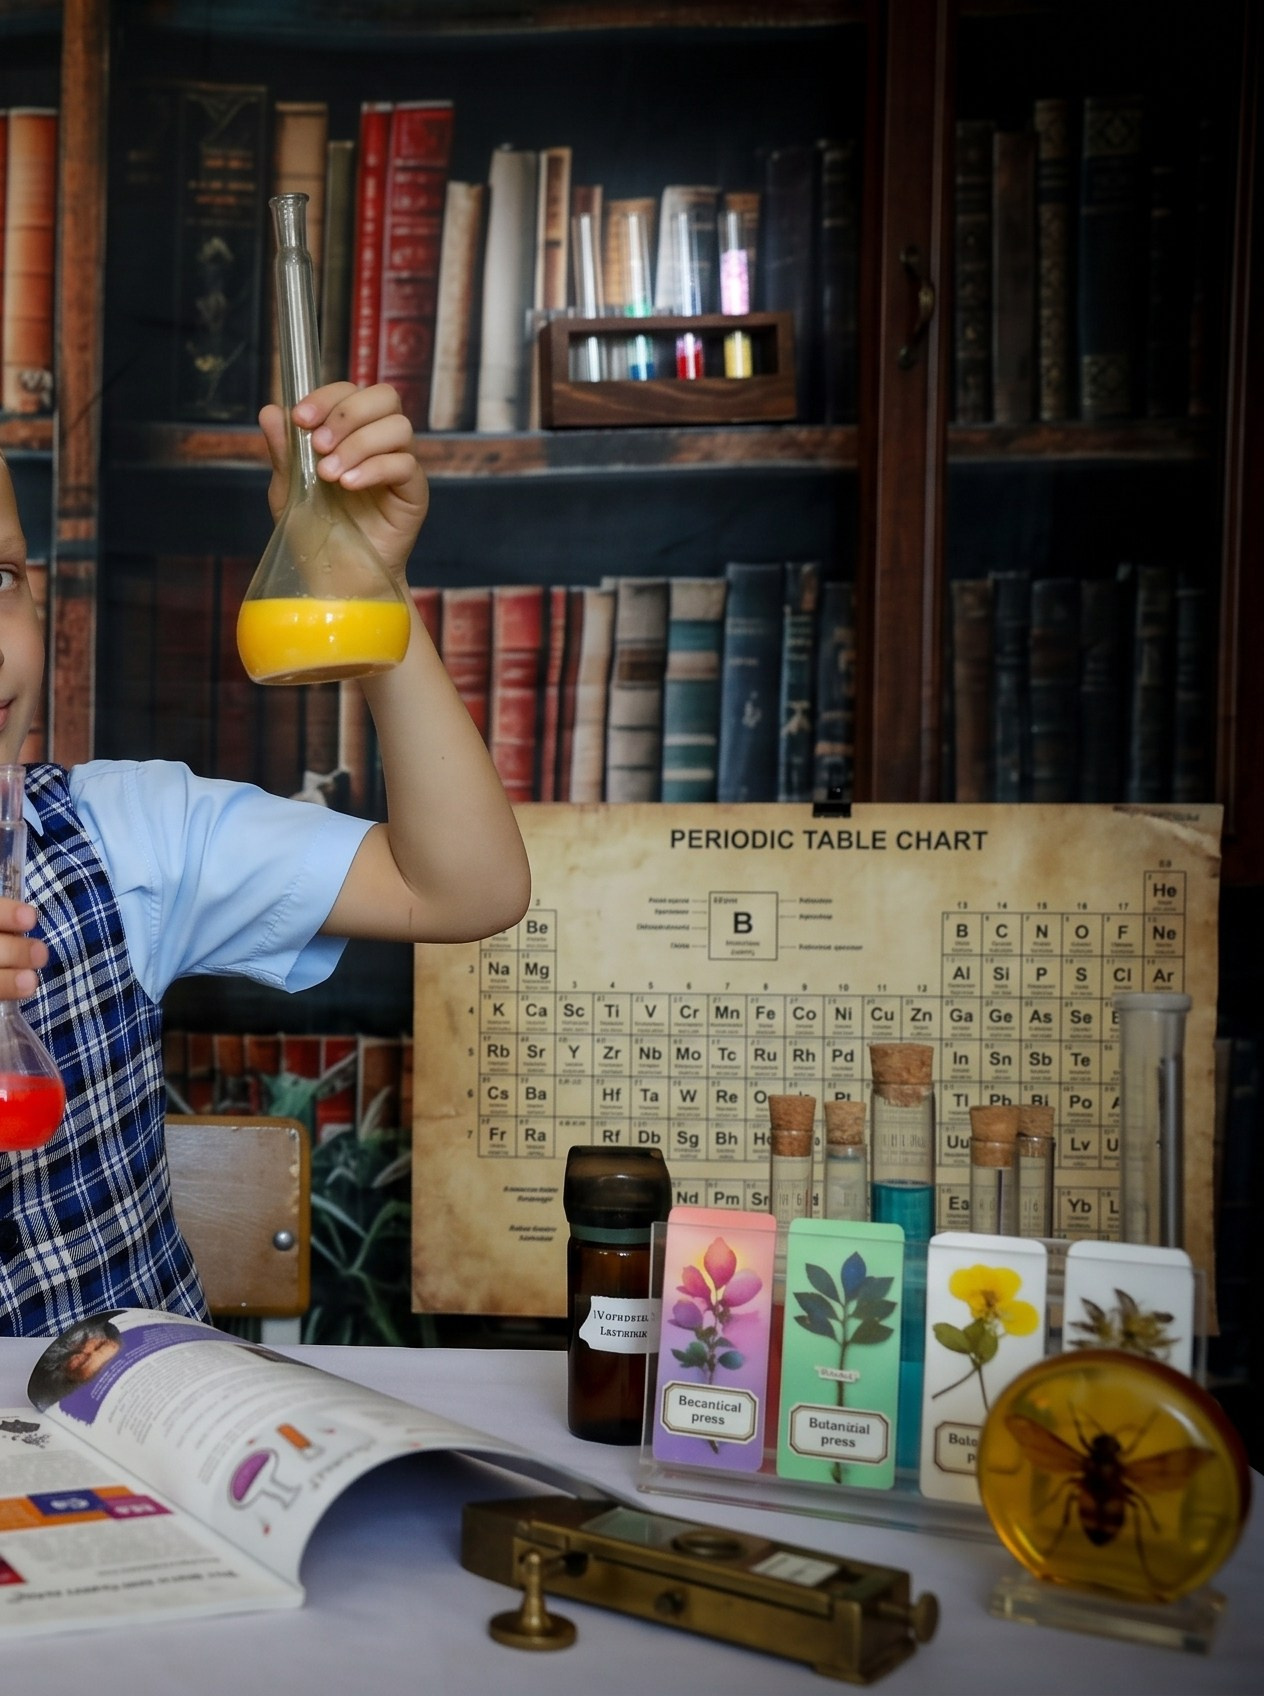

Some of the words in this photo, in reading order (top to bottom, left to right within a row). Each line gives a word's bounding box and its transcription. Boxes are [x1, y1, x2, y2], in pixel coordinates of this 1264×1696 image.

[671, 830, 793, 849] PERIODIC
[803, 830, 886, 850] TABLE
[896, 831, 988, 850] CHART
[1154, 883, 1177, 897] He
[527, 920, 548, 934] Be
[734, 912, 752, 933] B
[957, 924, 968, 938] B
[996, 924, 1007, 938] C
[1037, 925, 1048, 938] N
[1075, 925, 1089, 939] O
[1118, 925, 1128, 939] F
[1153, 926, 1176, 940] Ne
[489, 962, 509, 975] Na
[525, 962, 549, 979] Mg
[953, 966, 970, 980] Al
[993, 967, 1009, 981] Si
[1037, 967, 1047, 981] P
[1076, 967, 1087, 982] S
[1114, 968, 1131, 982] Cl
[1153, 969, 1174, 982] Ar
[493, 1003, 504, 1016] K
[526, 1004, 547, 1017] Ca
[564, 1003, 584, 1017] Sc
[604, 1004, 619, 1018] Ti
[645, 1005, 656, 1018] V
[680, 1005, 699, 1019] Cr
[716, 1006, 739, 1019] Mn
[756, 1006, 775, 1020] Fe
[793, 1007, 816, 1020] Co
[836, 1007, 851, 1020] Ni
[871, 1007, 894, 1021] Cu
[910, 1008, 932, 1021] Zn
[950, 1008, 973, 1022] Ga
[989, 1009, 1012, 1023] Ge
[1030, 1010, 1052, 1023] As
[1070, 1010, 1092, 1024] Se
[487, 1044, 510, 1057] Rb
[527, 1045, 545, 1058] Sr
[569, 1045, 579, 1058] Y
[603, 1046, 621, 1059] Zr
[640, 1047, 661, 1060] Nb
[676, 1047, 701, 1060] Mo
[718, 1048, 736, 1061] Tc
[754, 1048, 776, 1061] Ru
[793, 1049, 815, 1062] Rh
[832, 1049, 854, 1062] Pd
[954, 1052, 968, 1065] In
[990, 1052, 1011, 1065] Sn
[1029, 1052, 1052, 1066] Sb
[1071, 1053, 1090, 1067] Te
[487, 1086, 509, 1100] Cs
[526, 1087, 546, 1100] Ba
[603, 1088, 621, 1101] Hf
[640, 1089, 658, 1102] Ta
[680, 1090, 697, 1102] W
[717, 1090, 738, 1103] Re
[954, 1094, 968, 1107] Tl
[990, 1094, 1011, 1106] Pb
[1032, 1095, 1048, 1106] Bi
[1070, 1095, 1092, 1109] Po
[490, 1127, 506, 1141] Fr
[525, 1128, 546, 1142] Ra
[603, 1130, 620, 1143] Rf
[639, 1130, 661, 1144] Db
[677, 1131, 698, 1148] Sg
[716, 1132, 737, 1145] Bh
[1071, 1138, 1090, 1151] Lv
[677, 1192, 698, 1204] Nd
[714, 1192, 739, 1205] Pm
[1068, 1199, 1091, 1213] Yb
[679, 1395, 741, 1413] Becantical
[692, 1412, 725, 1425] press
[821, 1436, 856, 1448] press
